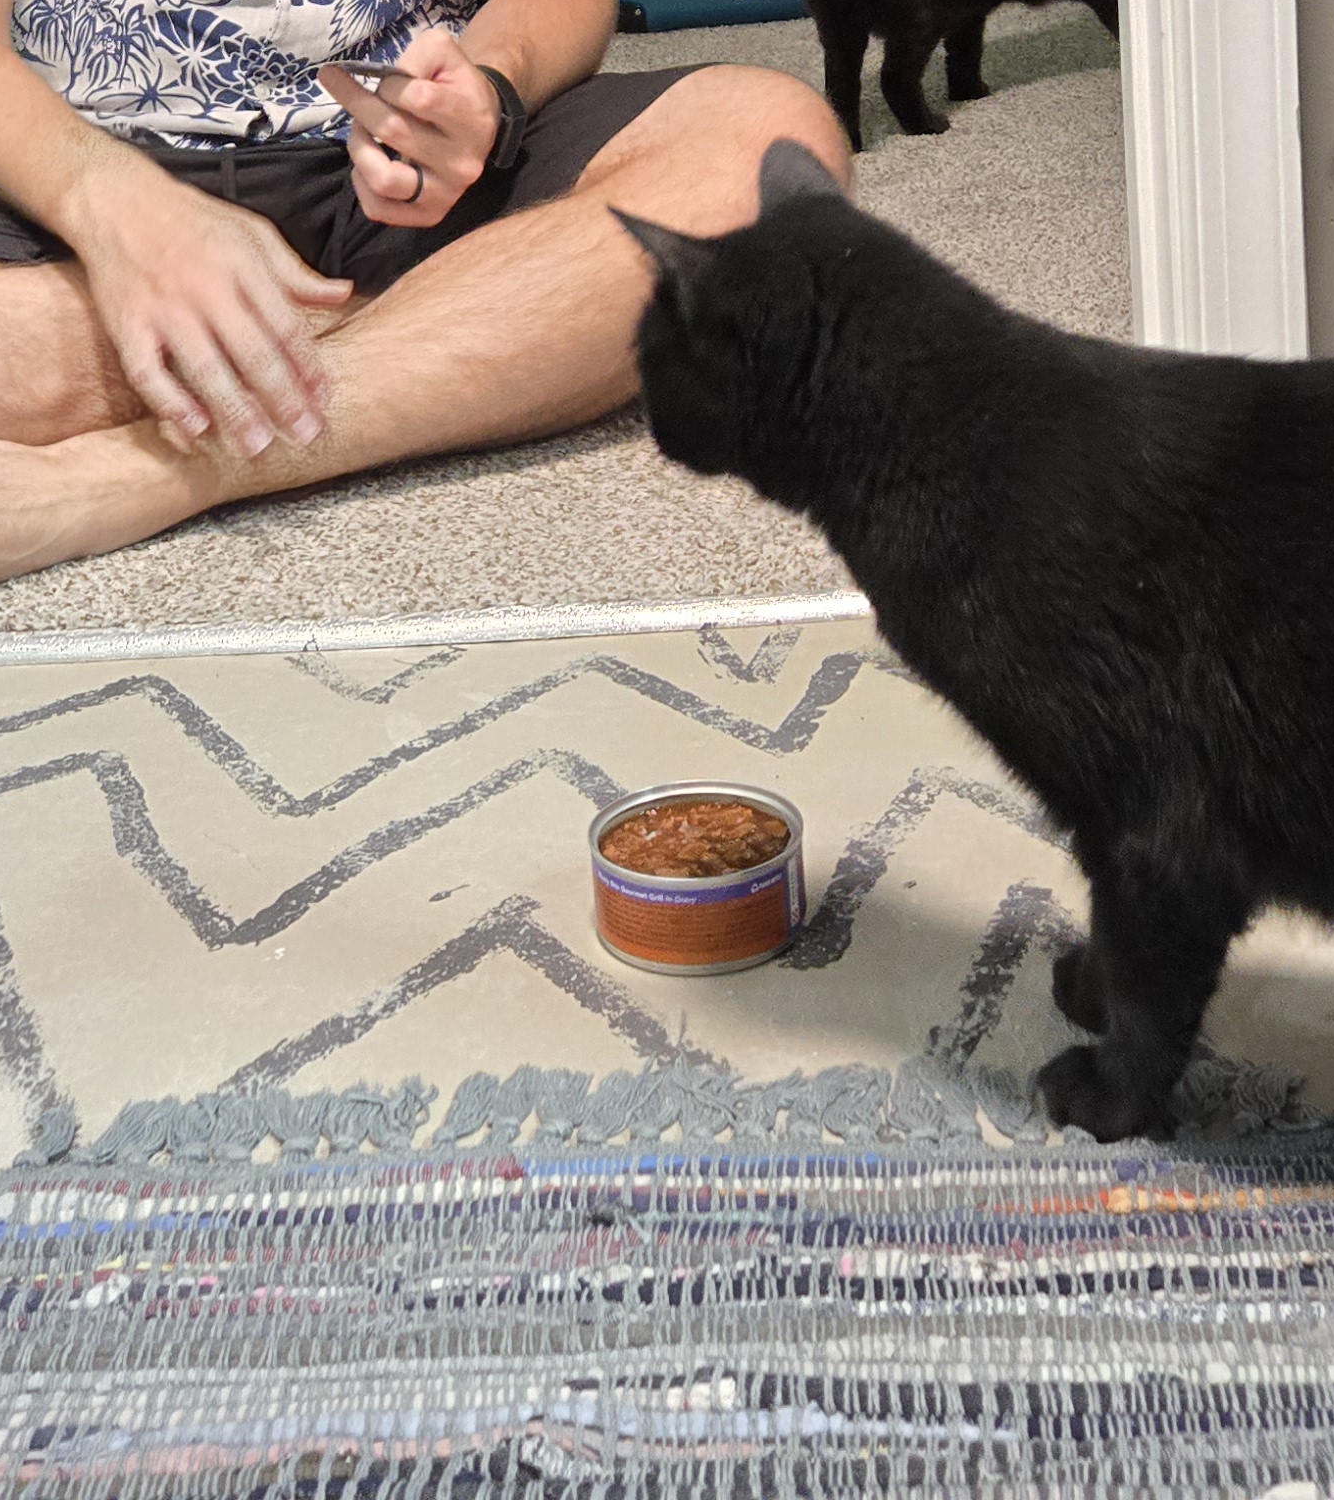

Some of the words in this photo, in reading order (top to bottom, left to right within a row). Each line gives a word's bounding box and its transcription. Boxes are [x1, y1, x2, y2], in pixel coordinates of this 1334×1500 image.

[620, 885, 647, 899] Gourmet
[648, 893, 664, 902] Grill
[674, 895, 697, 905] Gravy
